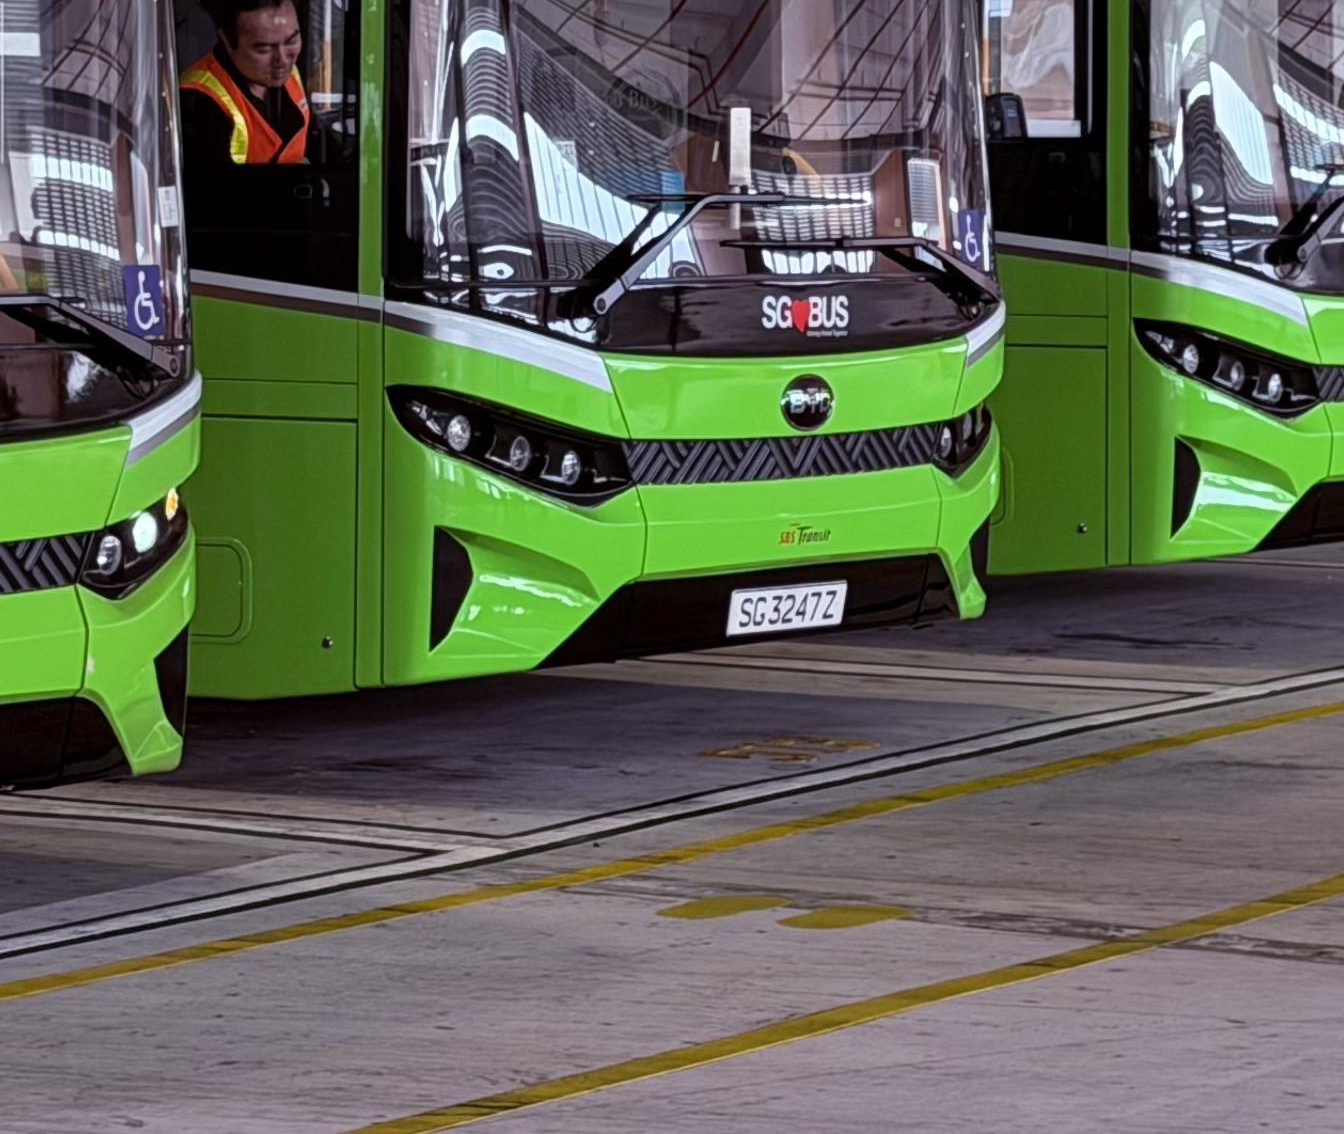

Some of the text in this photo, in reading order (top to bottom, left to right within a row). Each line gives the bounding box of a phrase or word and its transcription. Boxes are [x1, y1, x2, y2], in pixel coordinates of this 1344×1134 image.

[761, 295, 849, 329] SG BUS
[790, 390, 830, 414] BYD
[739, 590, 837, 628] SG3247Z
